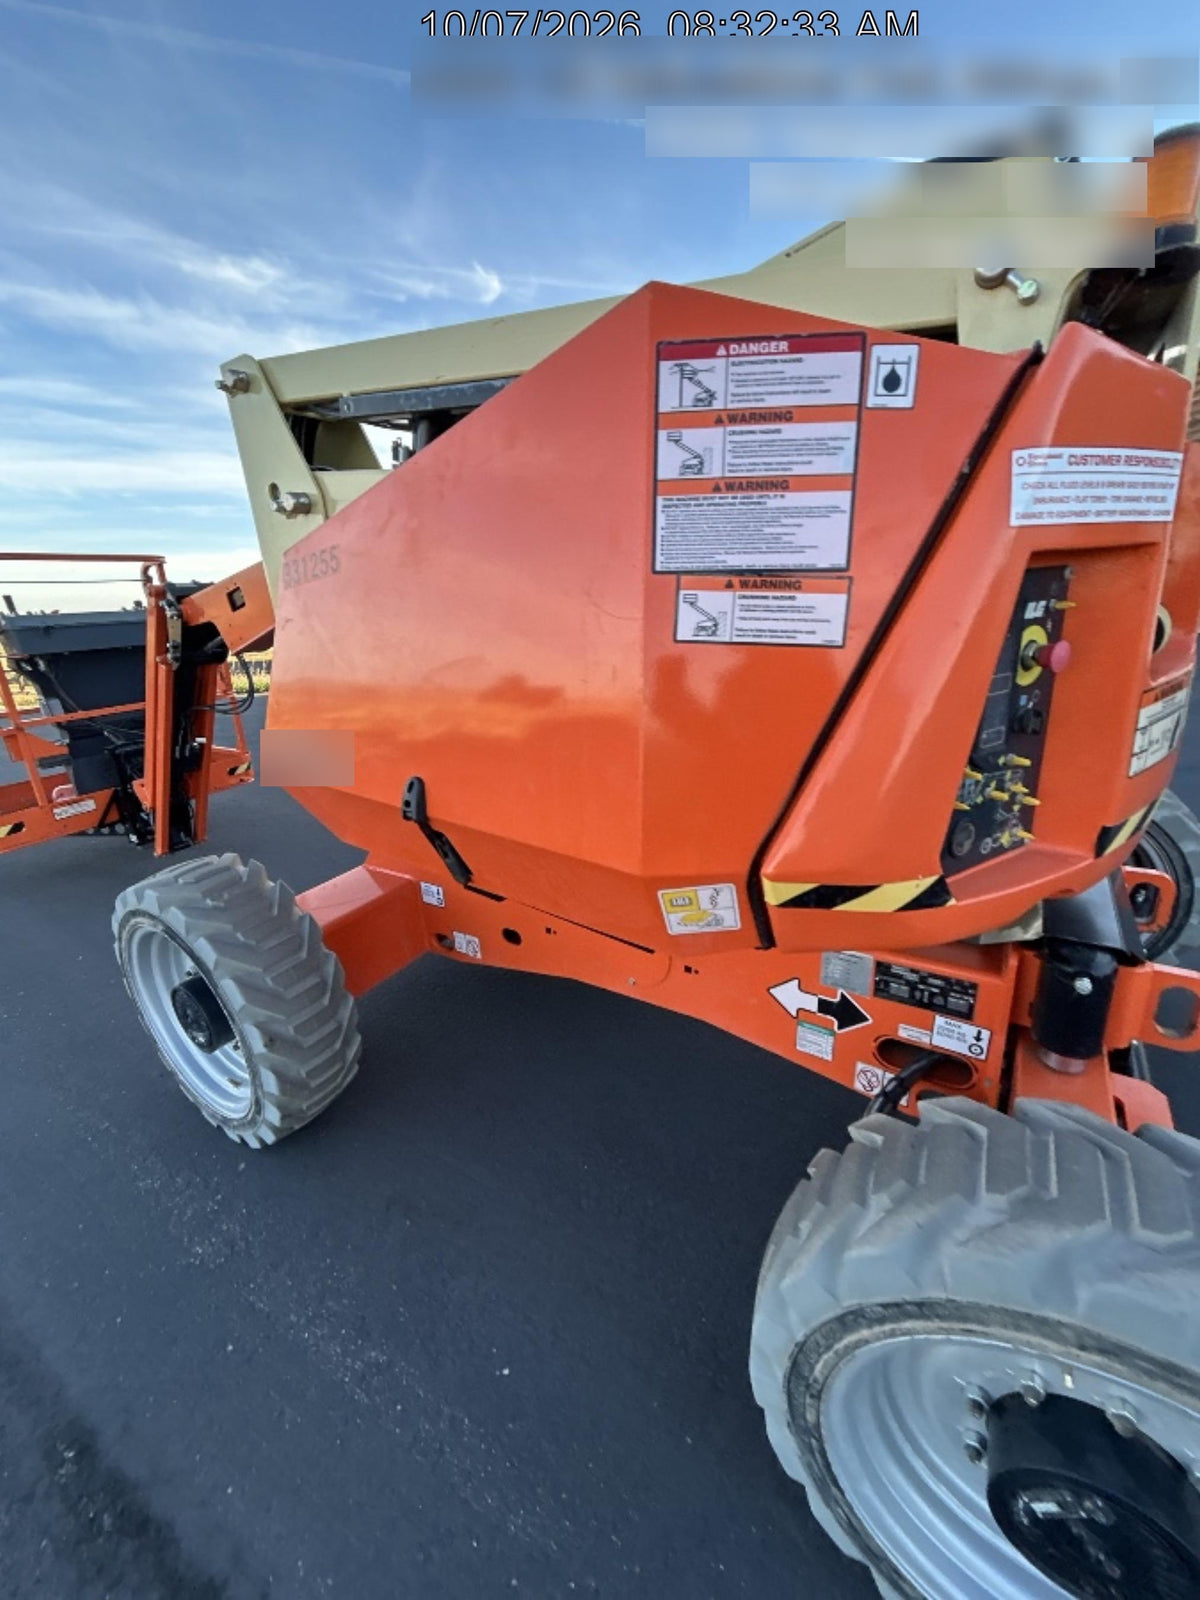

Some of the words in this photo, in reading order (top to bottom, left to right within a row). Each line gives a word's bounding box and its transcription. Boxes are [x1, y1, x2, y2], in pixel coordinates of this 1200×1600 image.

[729, 341, 789, 356] DANGER
[726, 409, 794, 425] WARNING
[1067, 454, 1122, 468] CUSTOMER
[724, 479, 790, 492] WARNING
[738, 578, 802, 591] WARNING
